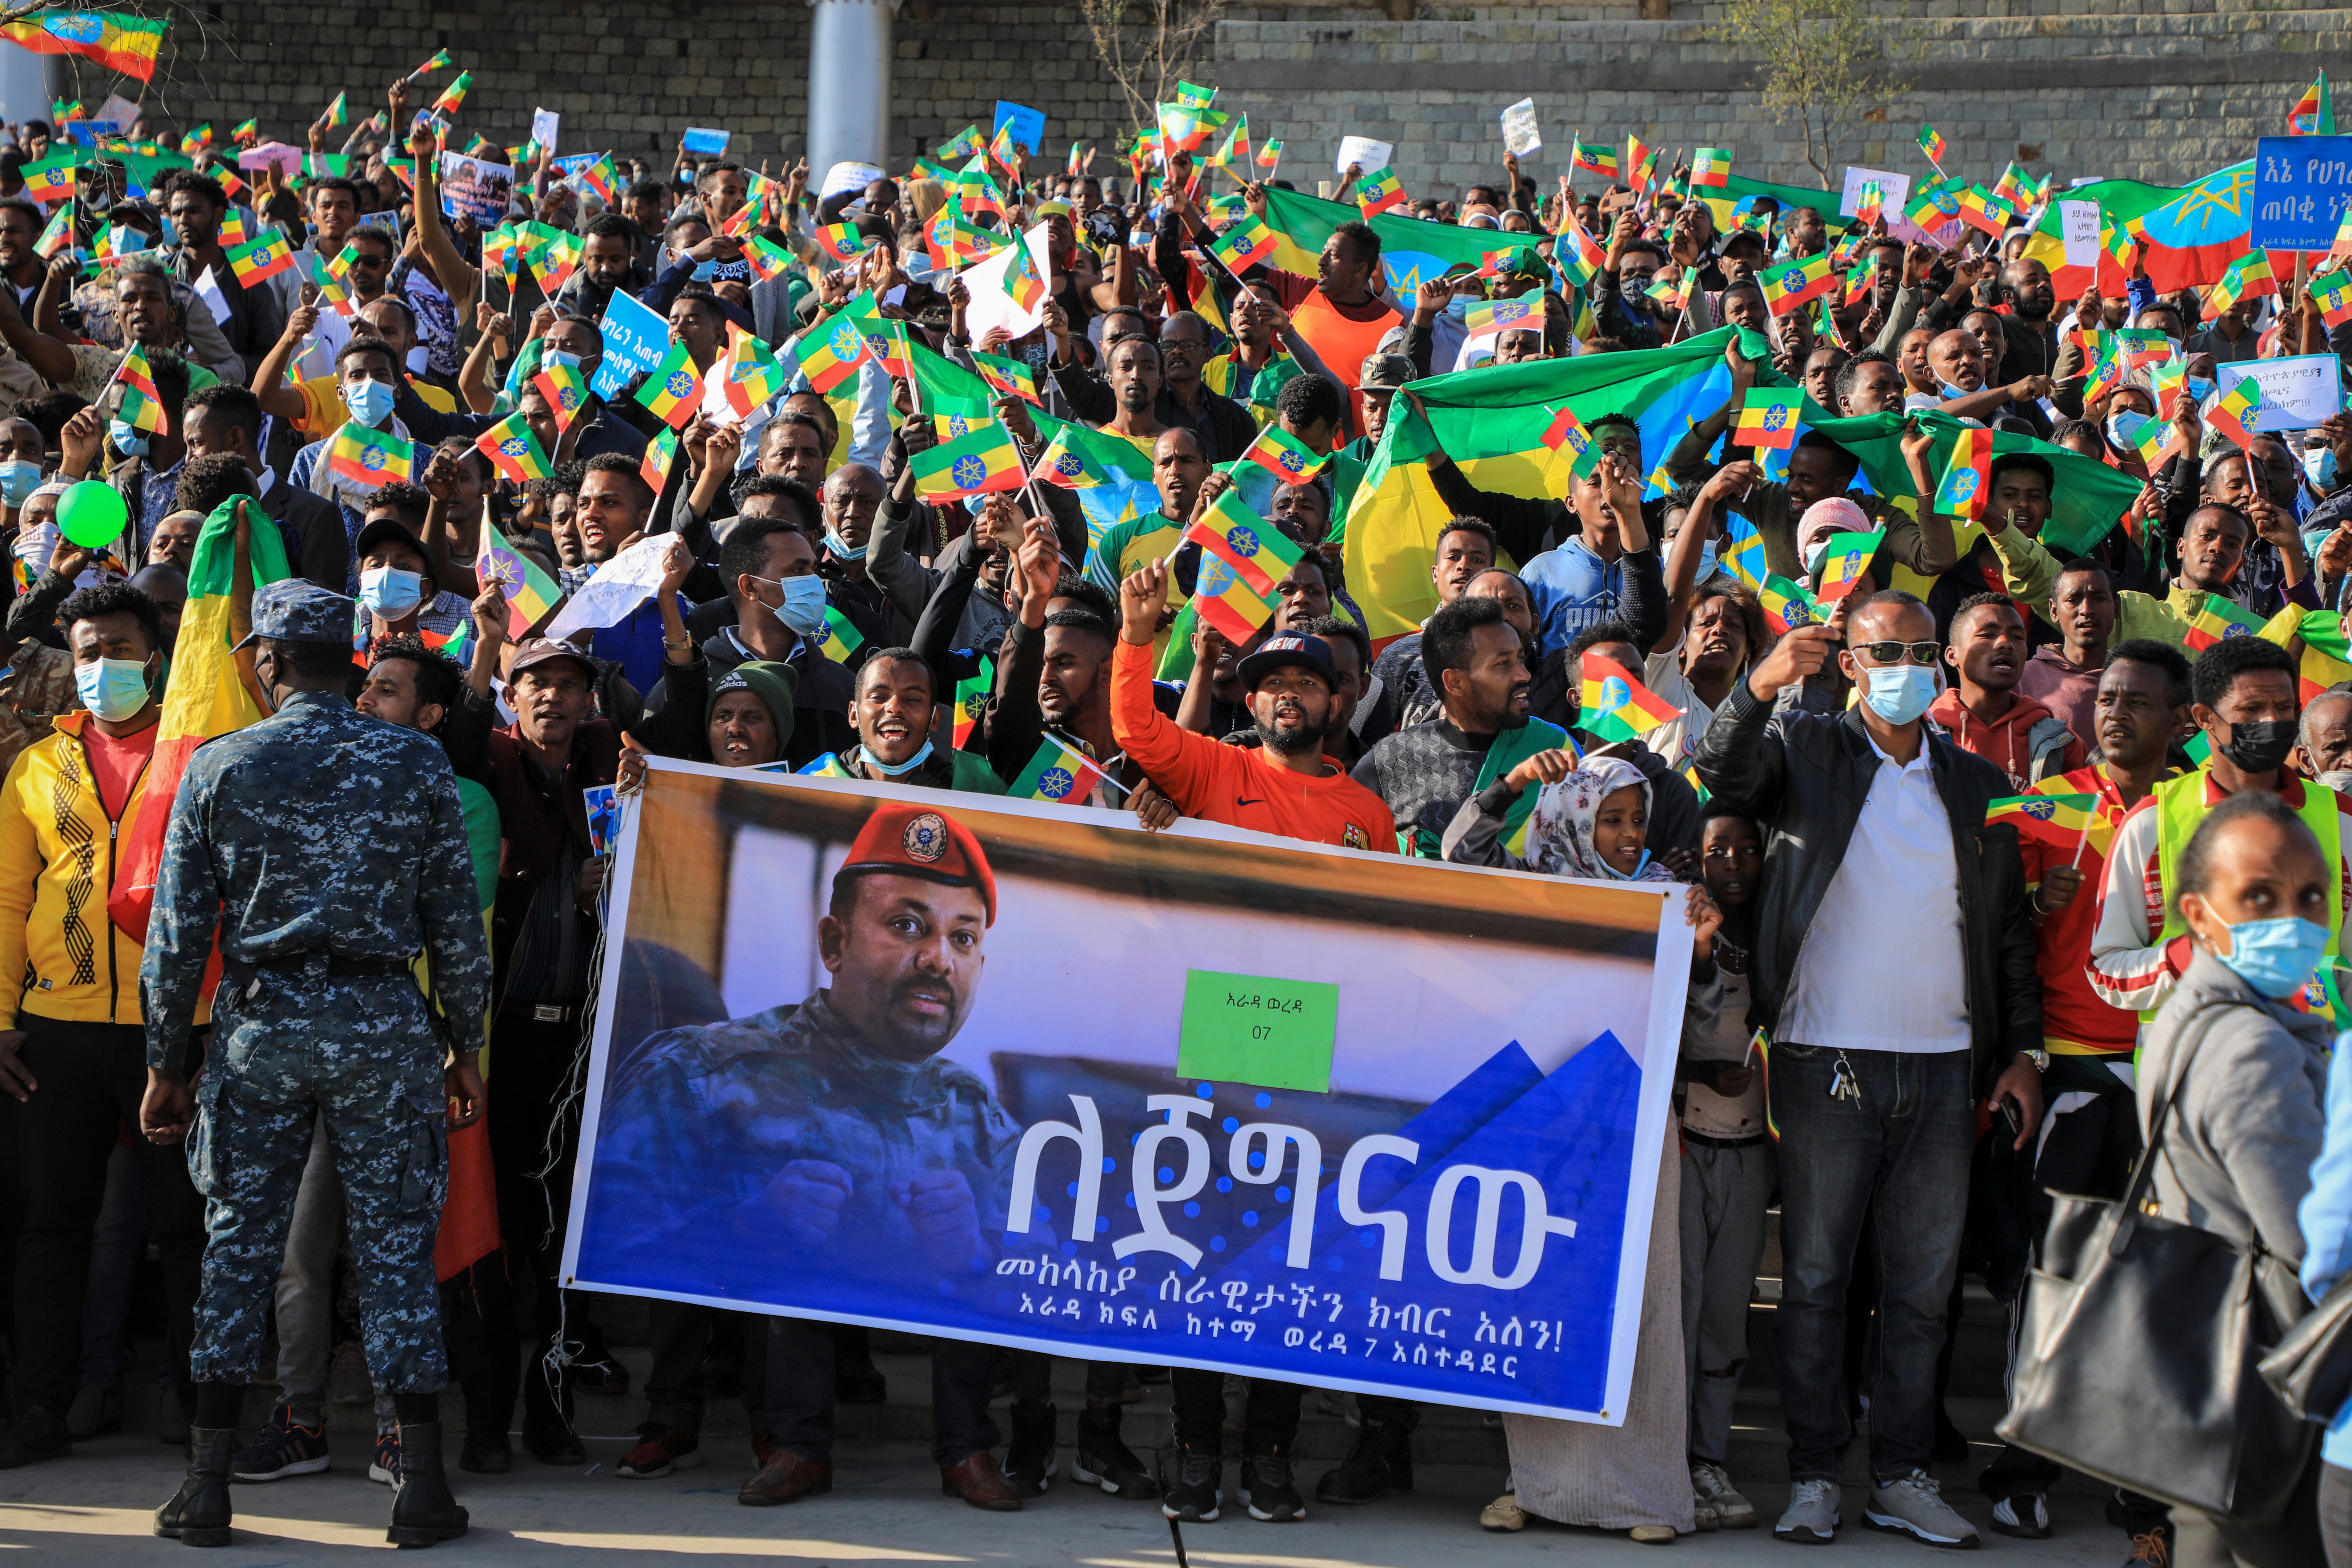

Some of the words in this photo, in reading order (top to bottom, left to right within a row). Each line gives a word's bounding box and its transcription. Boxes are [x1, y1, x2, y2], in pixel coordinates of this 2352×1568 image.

[2261, 195, 2315, 223] ጠባቂ
[1265, 637, 1302, 651] NEW
[716, 680, 747, 692] adidas
[1226, 992, 1260, 1009] አራዳ
[1267, 998, 1302, 1014] ወረዳ
[1252, 1026, 1271, 1040] 07
[1006, 1093, 1577, 1290] ለጀግናው
[996, 1254, 1137, 1297] መከላከያ
[1159, 1270, 1343, 1322] ሰራዊታችን
[1368, 1296, 1451, 1338] ክብር
[1474, 1311, 1563, 1353] አለን!
[1019, 1292, 1080, 1320] አራዳ
[1100, 1301, 1157, 1330] ክፍለ
[1187, 1312, 1256, 1342] ከተማ
[1284, 1327, 1347, 1355] ወረዳ
[1365, 1338, 1377, 1358] 7
[1392, 1341, 1517, 1379] አስተዳደር
